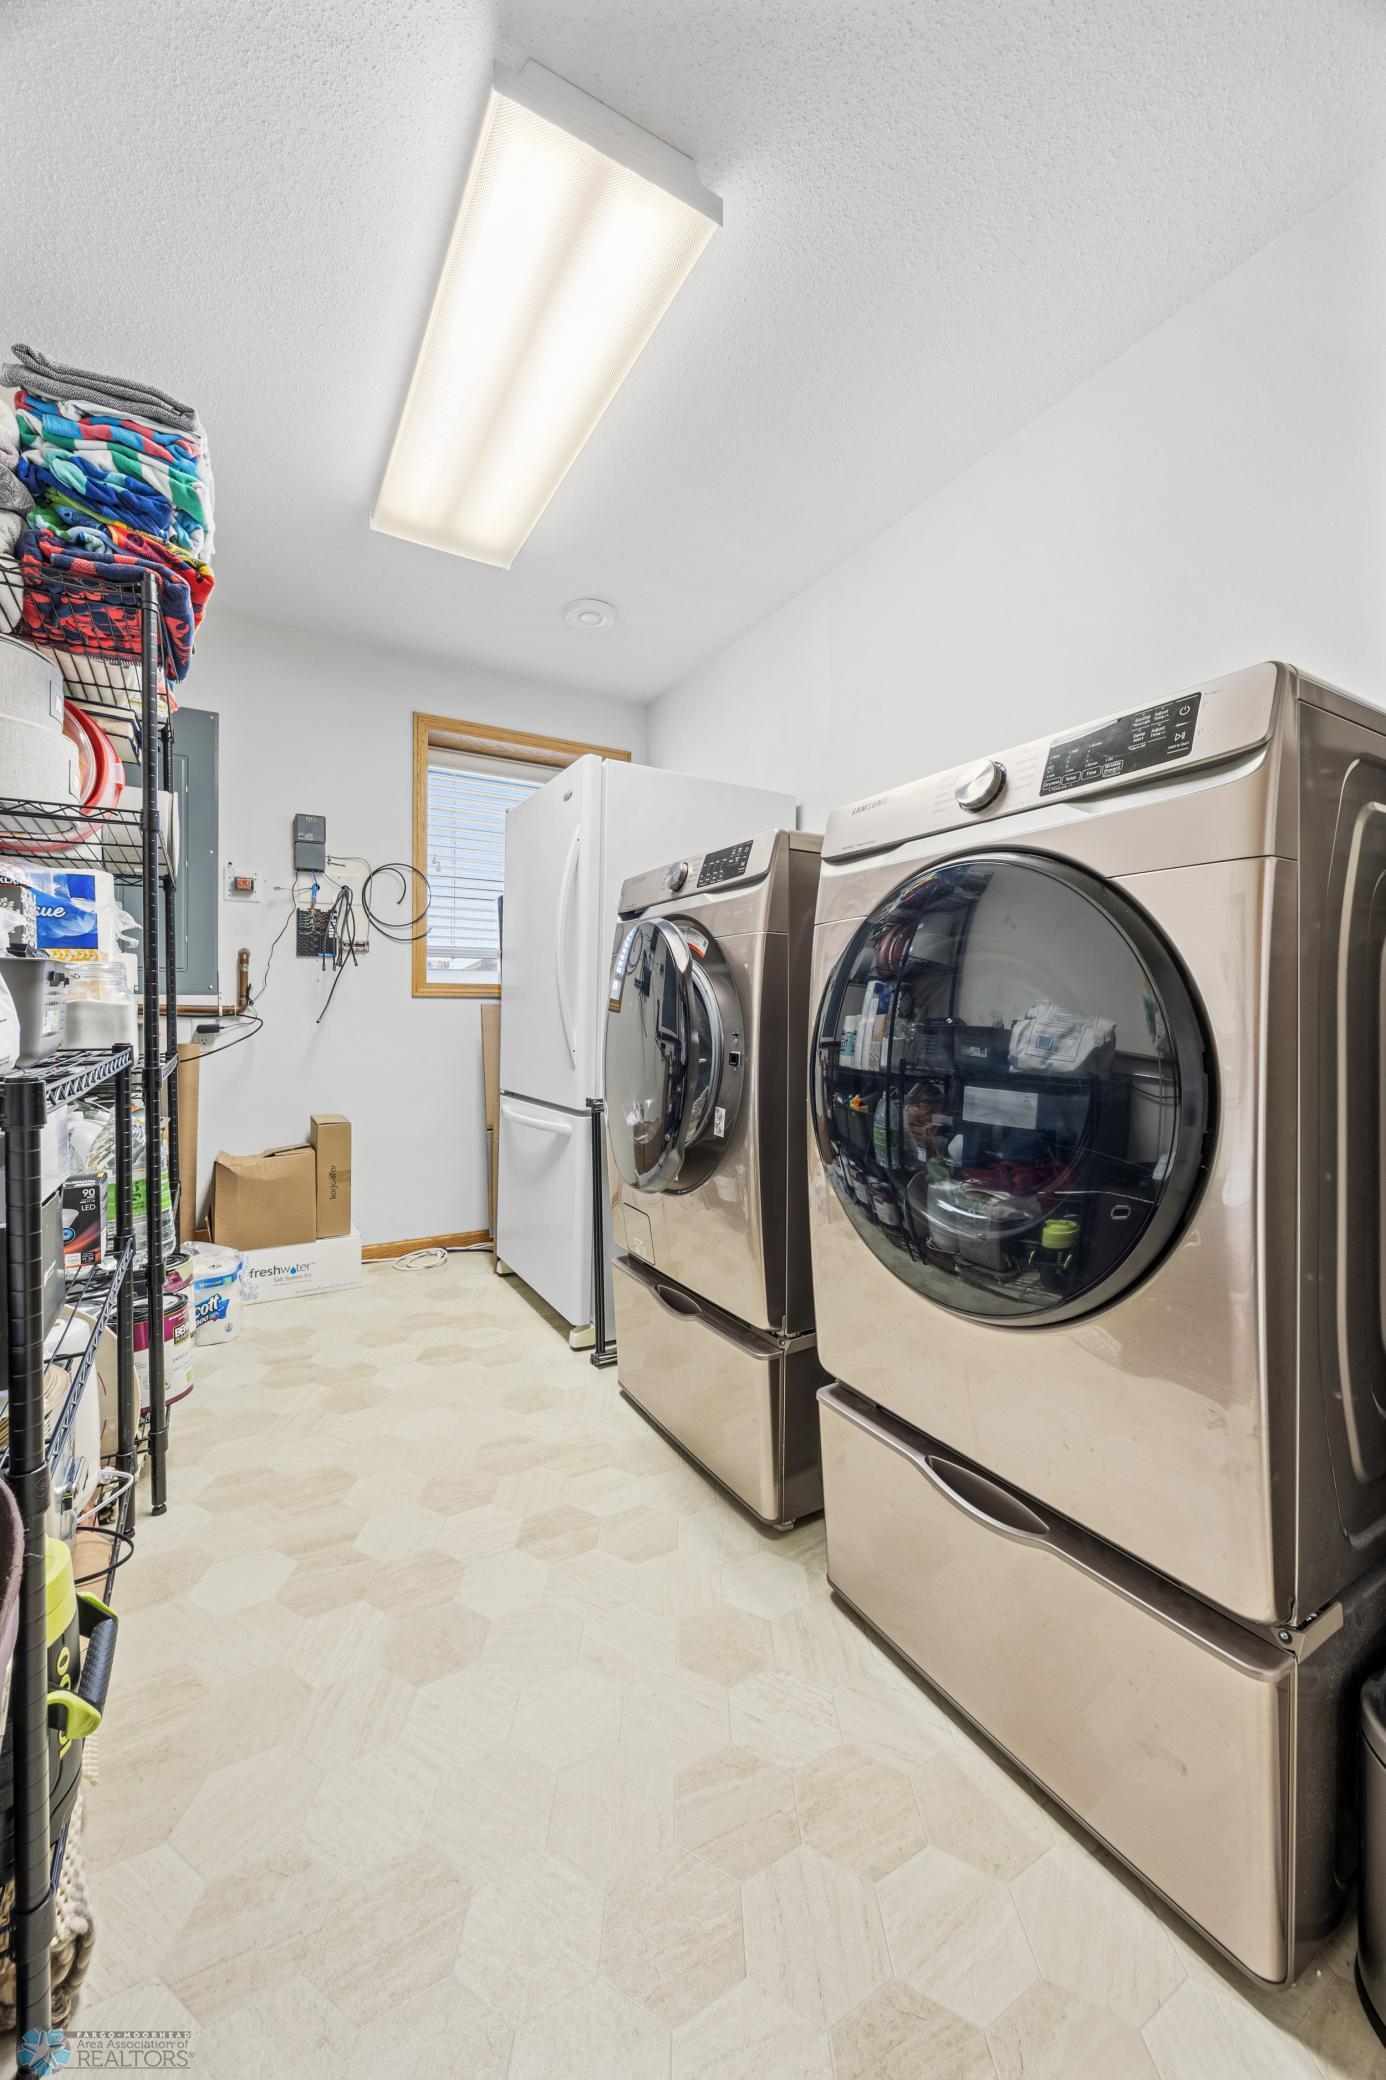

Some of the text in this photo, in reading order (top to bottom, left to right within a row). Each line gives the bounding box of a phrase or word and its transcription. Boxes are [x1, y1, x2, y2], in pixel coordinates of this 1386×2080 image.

[851, 798, 888, 816] SAMSUNG
[82, 1188, 96, 1197] 90
[81, 1203, 96, 1212] LED
